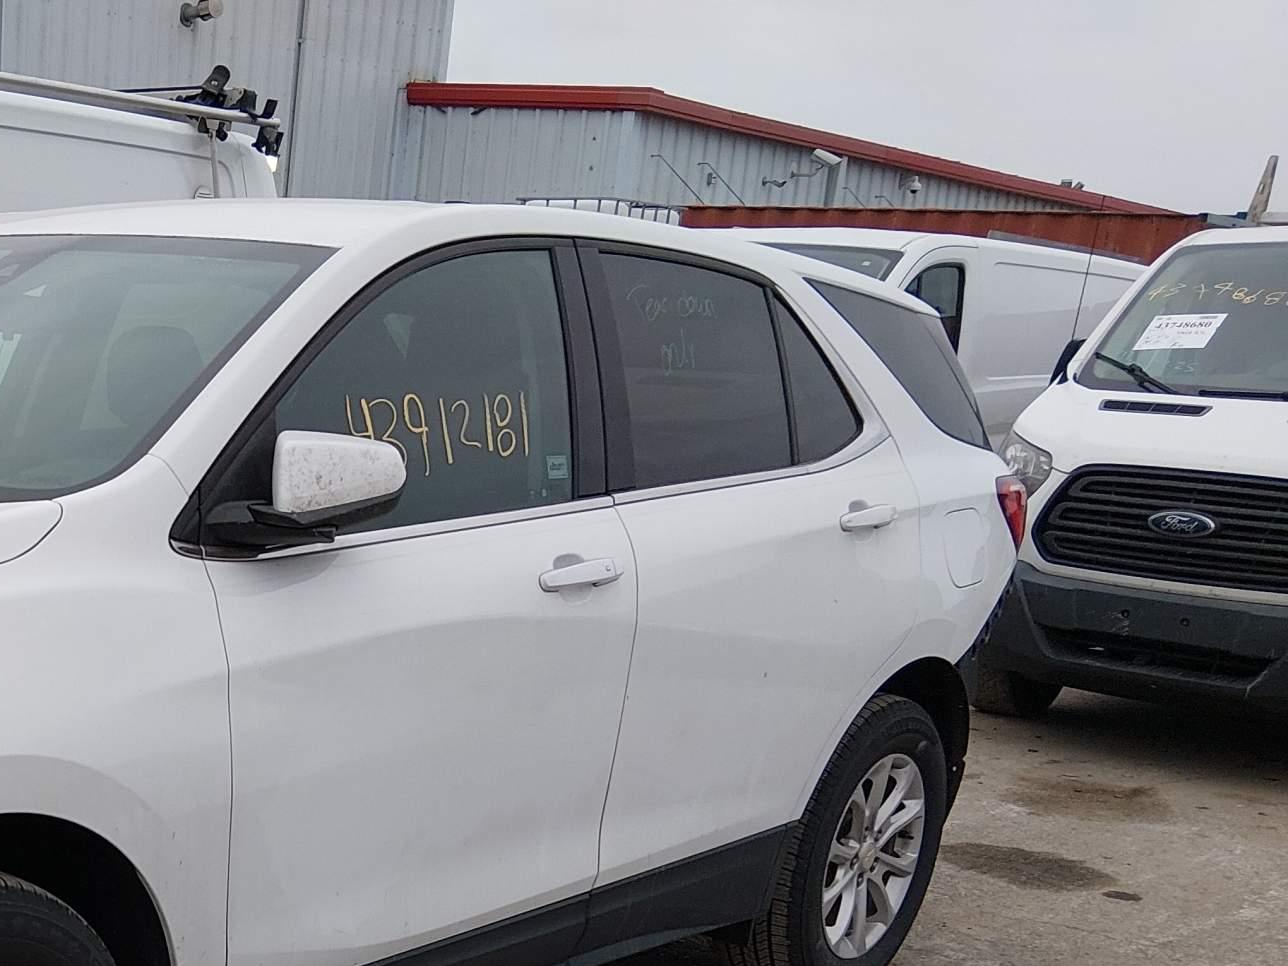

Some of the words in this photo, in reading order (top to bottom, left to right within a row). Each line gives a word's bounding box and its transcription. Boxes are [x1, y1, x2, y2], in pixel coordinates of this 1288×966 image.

[1148, 282, 1288, 306] 4374868
[346, 391, 528, 477] 43912181
[1162, 515, 1198, 532] Ford
